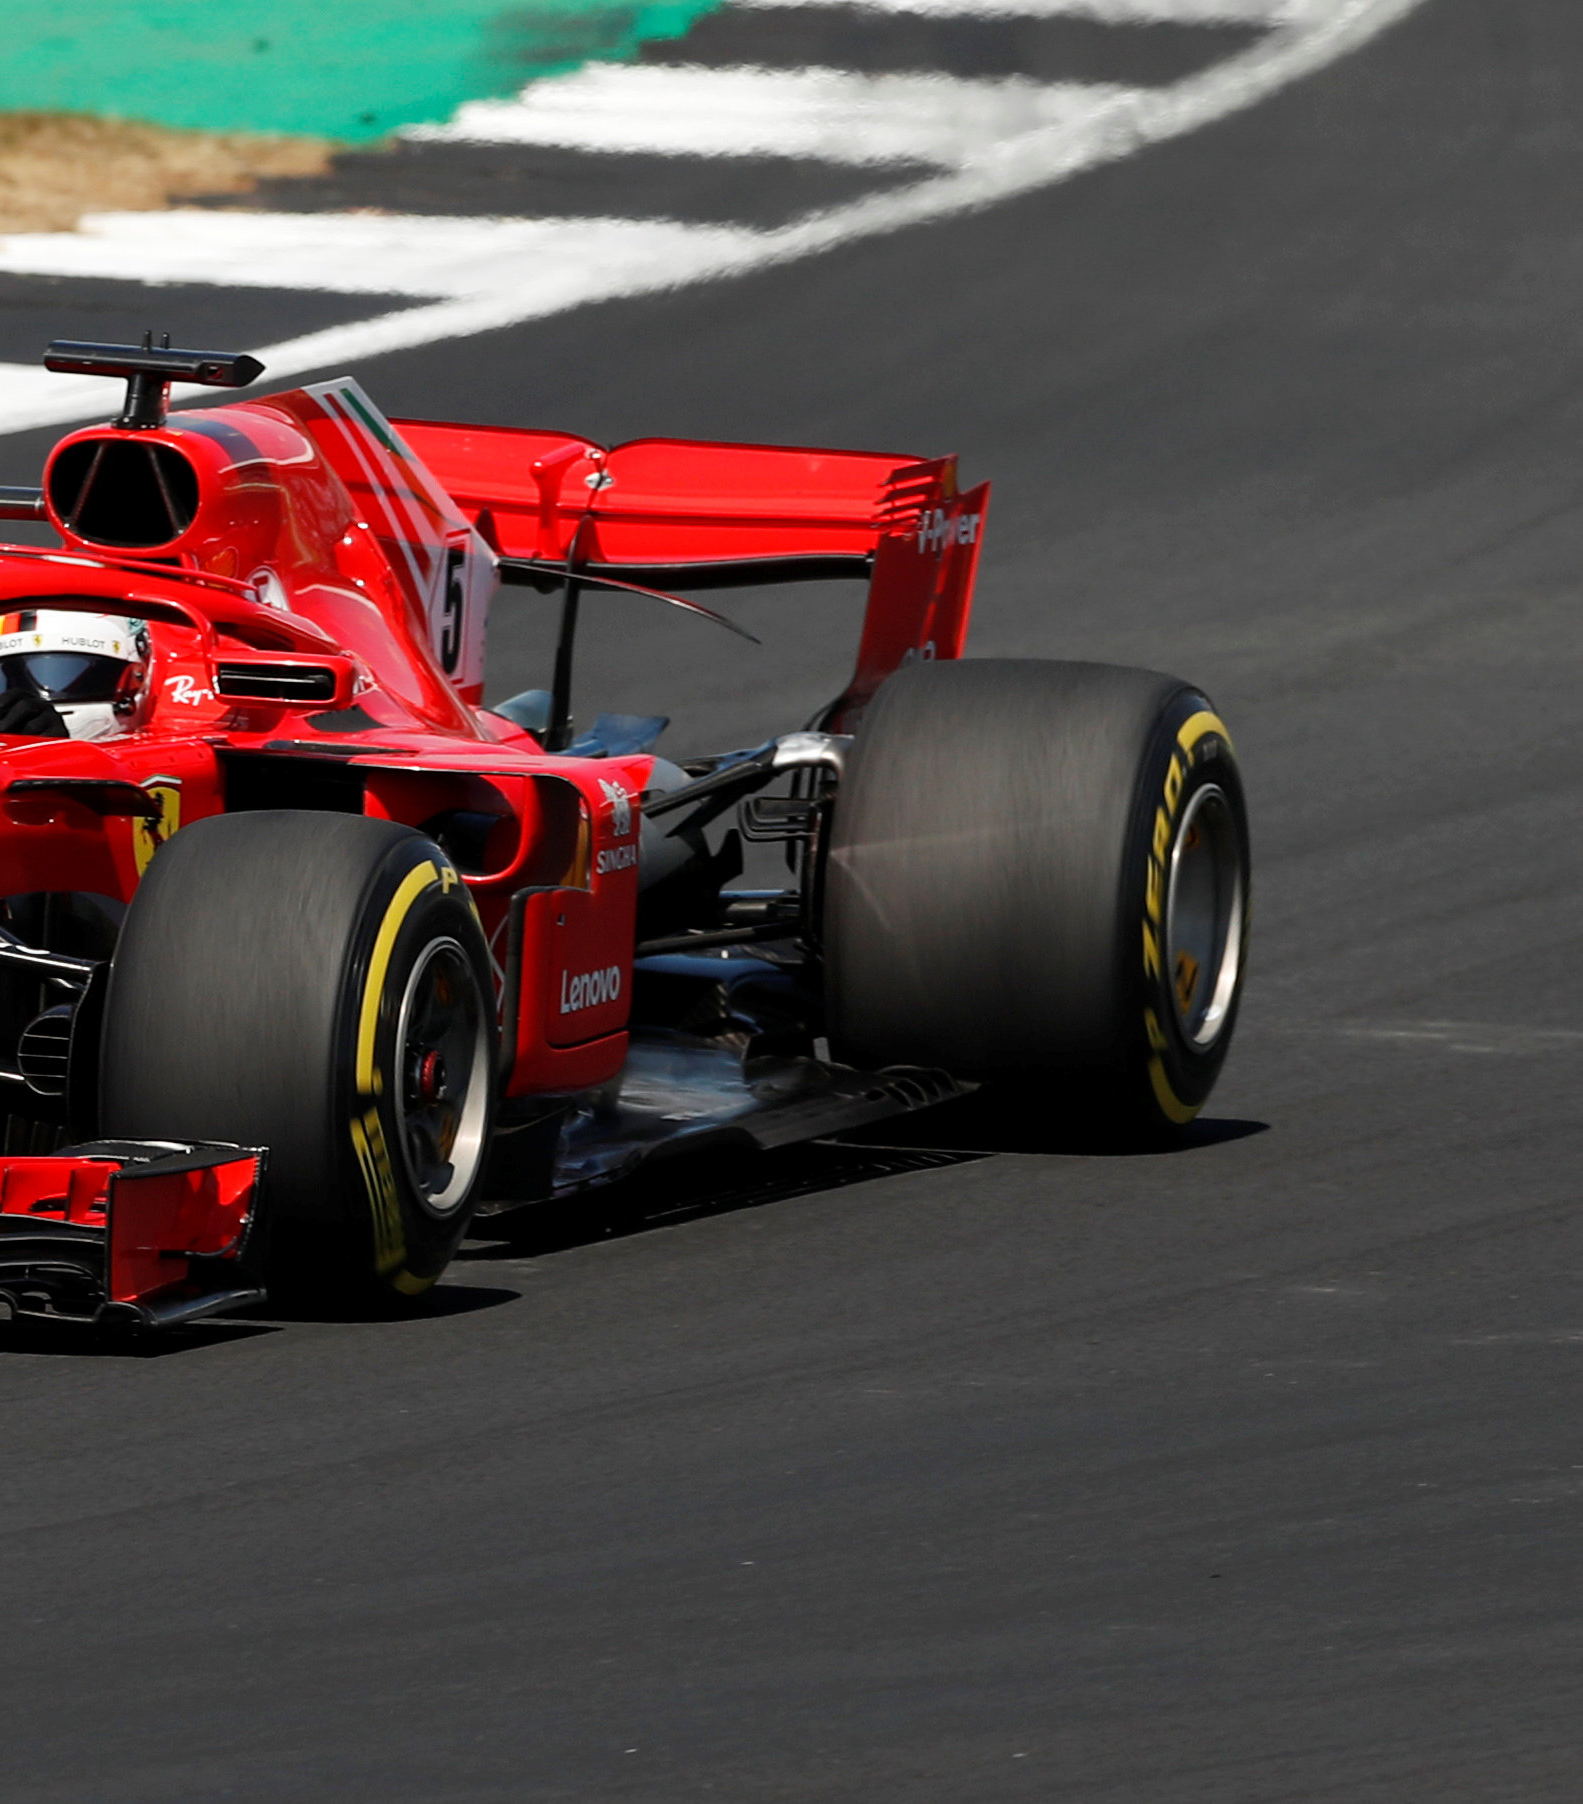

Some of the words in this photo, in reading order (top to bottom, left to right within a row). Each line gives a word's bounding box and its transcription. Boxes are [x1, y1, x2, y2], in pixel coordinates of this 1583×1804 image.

[441, 547, 465, 675] 5
[61, 637, 106, 650] HUBLOT
[596, 844, 637, 875] SINGHA
[560, 966, 621, 1014] Lenovo
